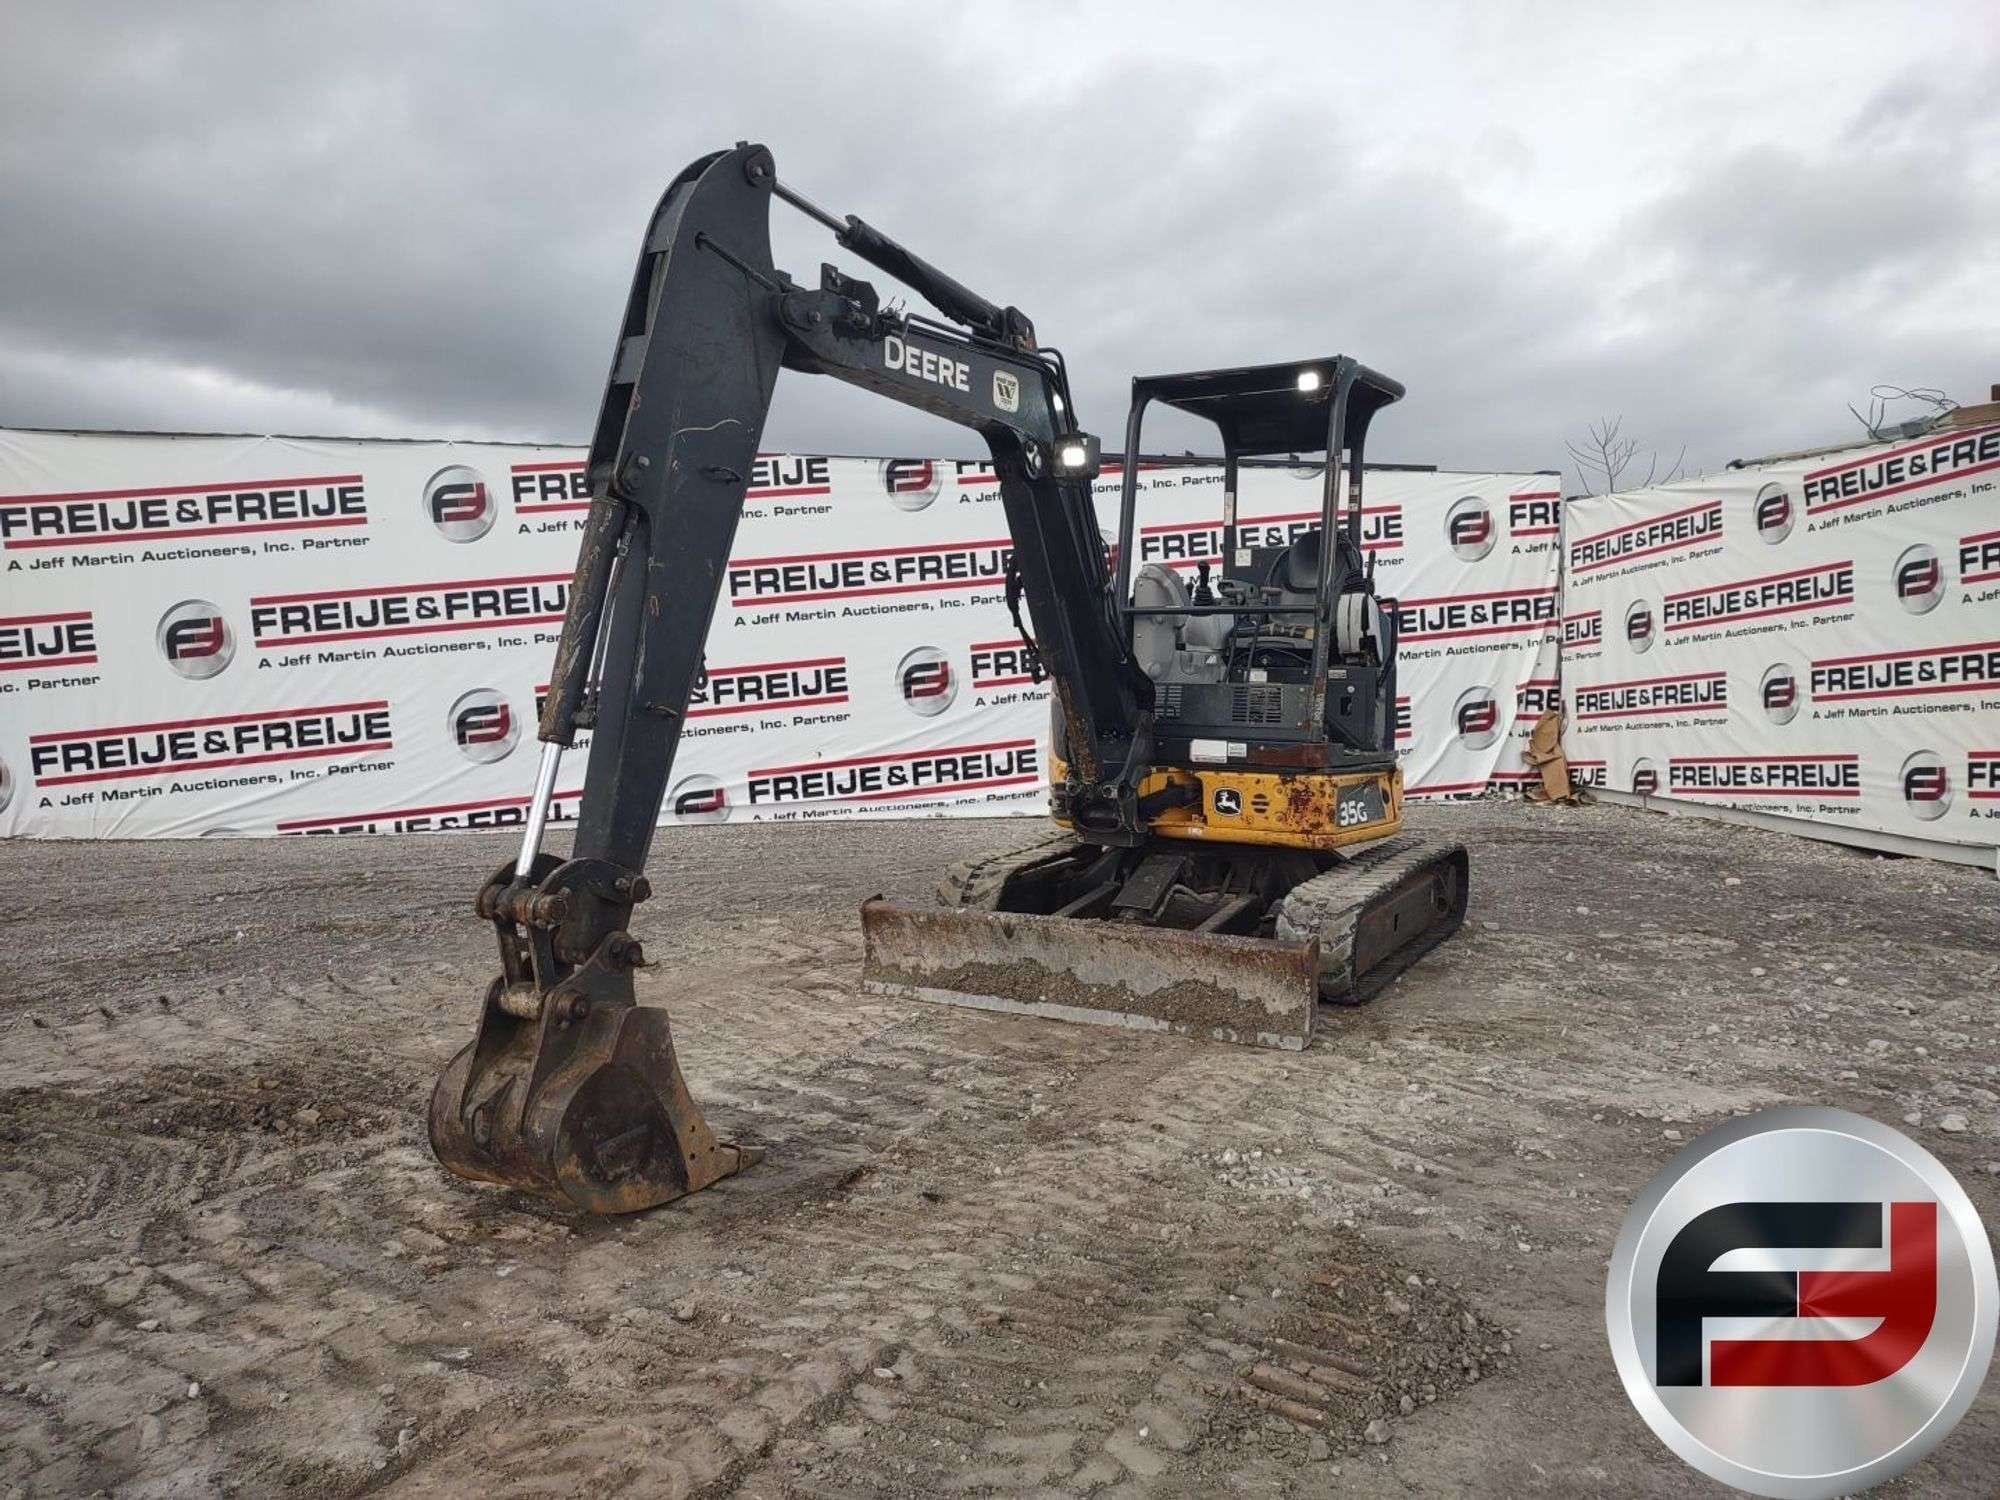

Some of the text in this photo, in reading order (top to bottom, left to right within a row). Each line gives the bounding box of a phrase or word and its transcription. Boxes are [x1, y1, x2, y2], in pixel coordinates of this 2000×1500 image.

[884, 336, 970, 392] DEERE
[1153, 479, 1176, 489] Inc.
[1804, 457, 1905, 506] FREIJE
[1, 499, 170, 537] FREIJE
[207, 486, 366, 523] FREIJE
[774, 505, 832, 516] Partner
[960, 494, 970, 503] A
[1807, 483, 1996, 532] A Jeff Martin Auctioneers, Inc.
[518, 523, 531, 534] A
[537, 521, 567, 533] Jeff
[1571, 536, 1633, 567] FREIJE
[1648, 508, 1722, 547] FREIJE
[7, 535, 370, 571] A Jeff Martin Auctioneers, Inc. Partner
[1141, 526, 1259, 561] FREIE
[1512, 545, 1520, 553] A
[1525, 543, 1547, 552] Jeff
[729, 561, 865, 597] FREIJE
[1580, 574, 1593, 585] Jeff
[1596, 571, 1619, 582] Martin
[1689, 546, 1724, 560] Partner
[251, 597, 411, 637] FREIJE
[445, 584, 572, 620] FREIJ
[734, 616, 746, 627] A
[751, 613, 780, 625] Jeff
[786, 608, 836, 623] Martin
[842, 600, 934, 617] Auctioneers,
[940, 597, 965, 608] Inc.
[1664, 591, 1741, 624] FREIJE
[1761, 569, 1854, 607] FREIJE
[1962, 594, 1972, 603] A
[1674, 633, 1690, 645] Jeff
[1692, 631, 1722, 644] Martin
[1725, 622, 1787, 639] Auctioneers,
[1790, 618, 1809, 629] Inc.
[1813, 611, 1855, 626] Partner
[258, 658, 272, 669] A
[279, 654, 311, 667] Jeff
[318, 648, 376, 664] Martin
[383, 638, 491, 658] Auctioneers,
[498, 634, 527, 647] Inc.
[1400, 646, 1441, 660] Martin
[1447, 640, 1522, 656] Auctioneers,
[1576, 651, 1603, 660] Partner
[28, 676, 100, 690] Partner
[713, 667, 848, 705] FREIJE
[1811, 661, 1913, 693] FREIJE
[975, 697, 986, 706] A
[992, 693, 1017, 704] Jeff
[1576, 688, 1637, 713] FREIJE
[1652, 680, 1727, 706] FREIJE
[1812, 711, 1821, 719] A
[1824, 708, 1845, 718] Jeff
[1848, 707, 1888, 718] Martin
[1893, 703, 1975, 714] Auctioneers,
[761, 719, 787, 731] Inc.
[793, 712, 850, 727] Partner
[1584, 723, 1598, 733] Jeff
[1600, 722, 1623, 732] Martin
[1693, 717, 1728, 726] Partner
[31, 731, 198, 775] FREIJE
[234, 711, 393, 753] FREIJE
[39, 760, 395, 808] A Jeff Martin Auctioneers, Inc. Partner
[749, 766, 882, 804] FREIJE
[913, 749, 1038, 786] FREIJE
[1669, 764, 1747, 787] FREIJE
[1767, 764, 1860, 787] FREIJE
[803, 806, 852, 819] Martin
[985, 790, 1040, 802] Partner
[1340, 801, 1368, 826] 35G
[1819, 804, 1861, 815] Partner
[1970, 808, 1980, 818] A
